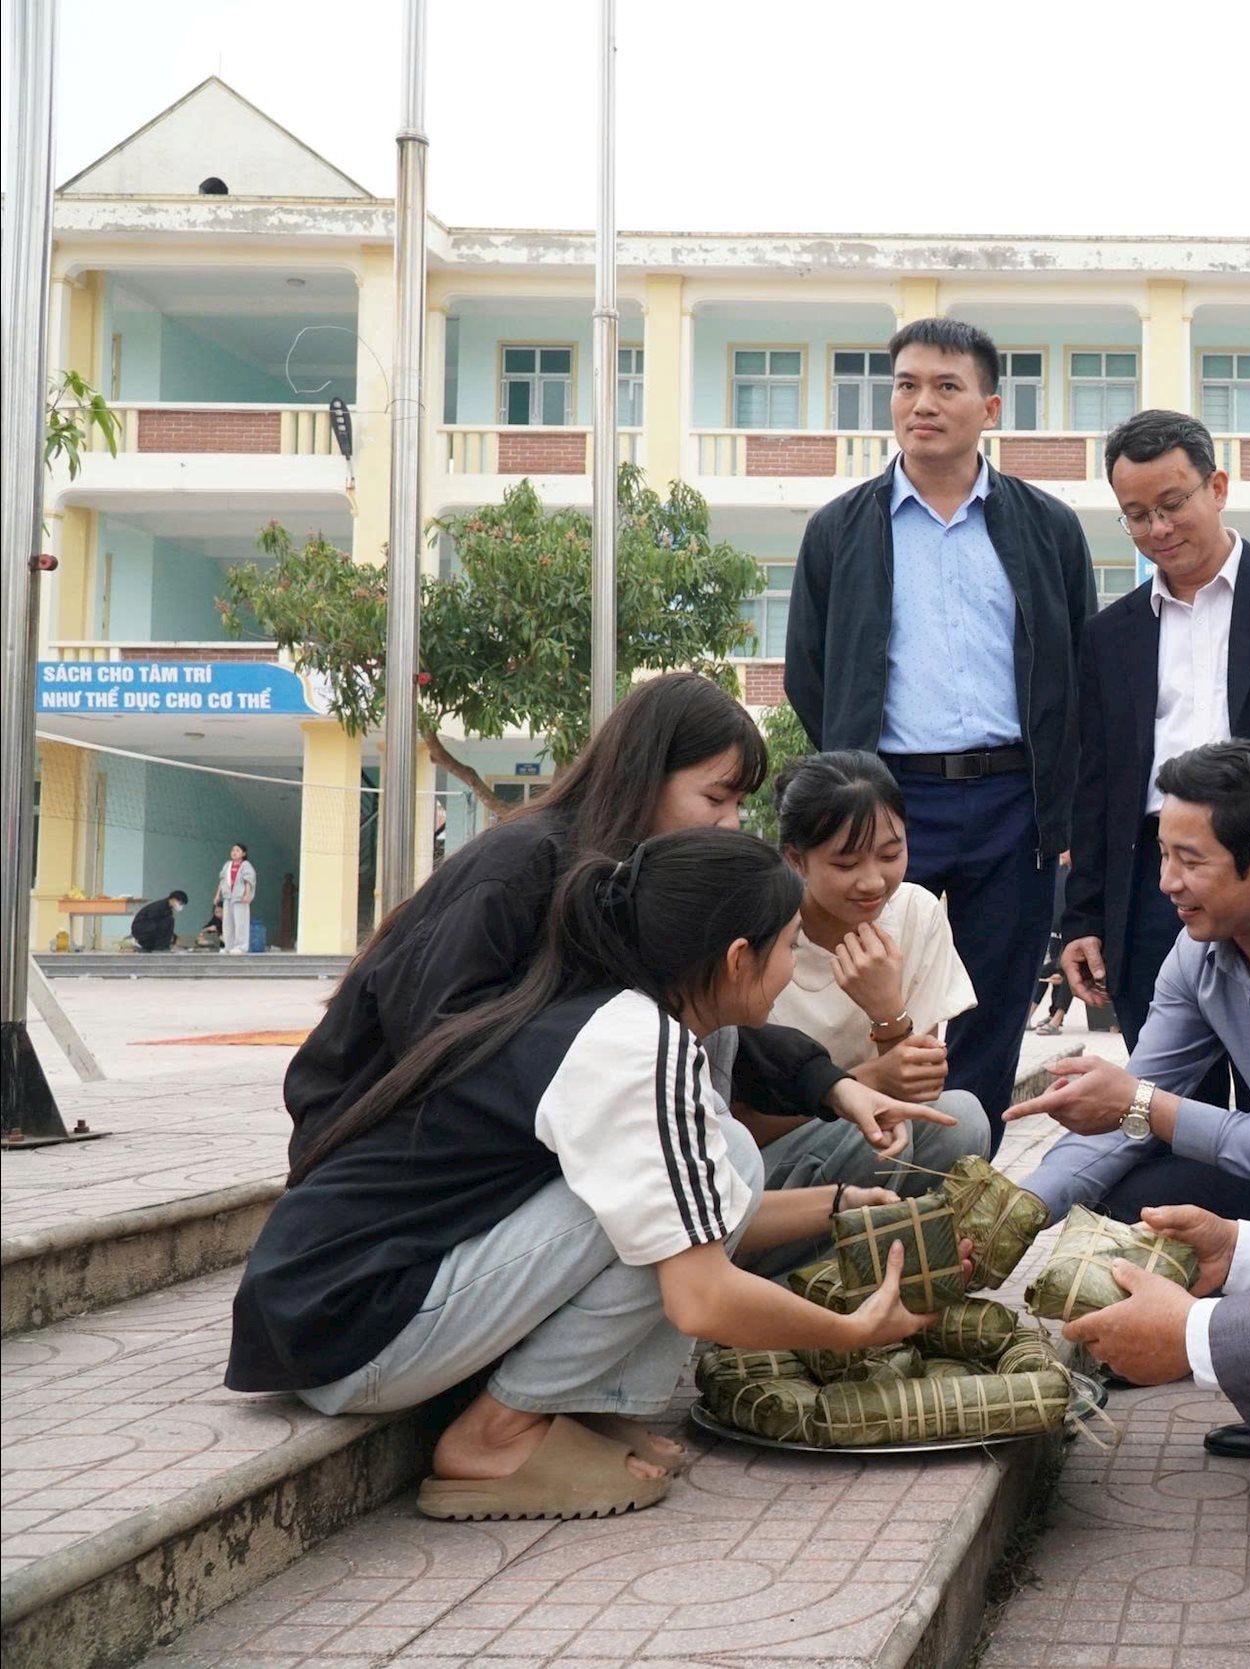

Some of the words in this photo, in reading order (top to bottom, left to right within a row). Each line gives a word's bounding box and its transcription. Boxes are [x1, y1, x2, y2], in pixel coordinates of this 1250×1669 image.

[43, 663, 92, 683] SÁCH
[97, 666, 134, 683] CHO
[140, 664, 178, 683] TÂM
[183, 664, 212, 683] TRÍ
[42, 691, 82, 708] NHƯ
[85, 686, 120, 708] THỂ
[124, 692, 160, 711] DỤC
[166, 692, 202, 709] CHO
[208, 691, 234, 709] CƠ
[237, 687, 272, 709] THỂ
